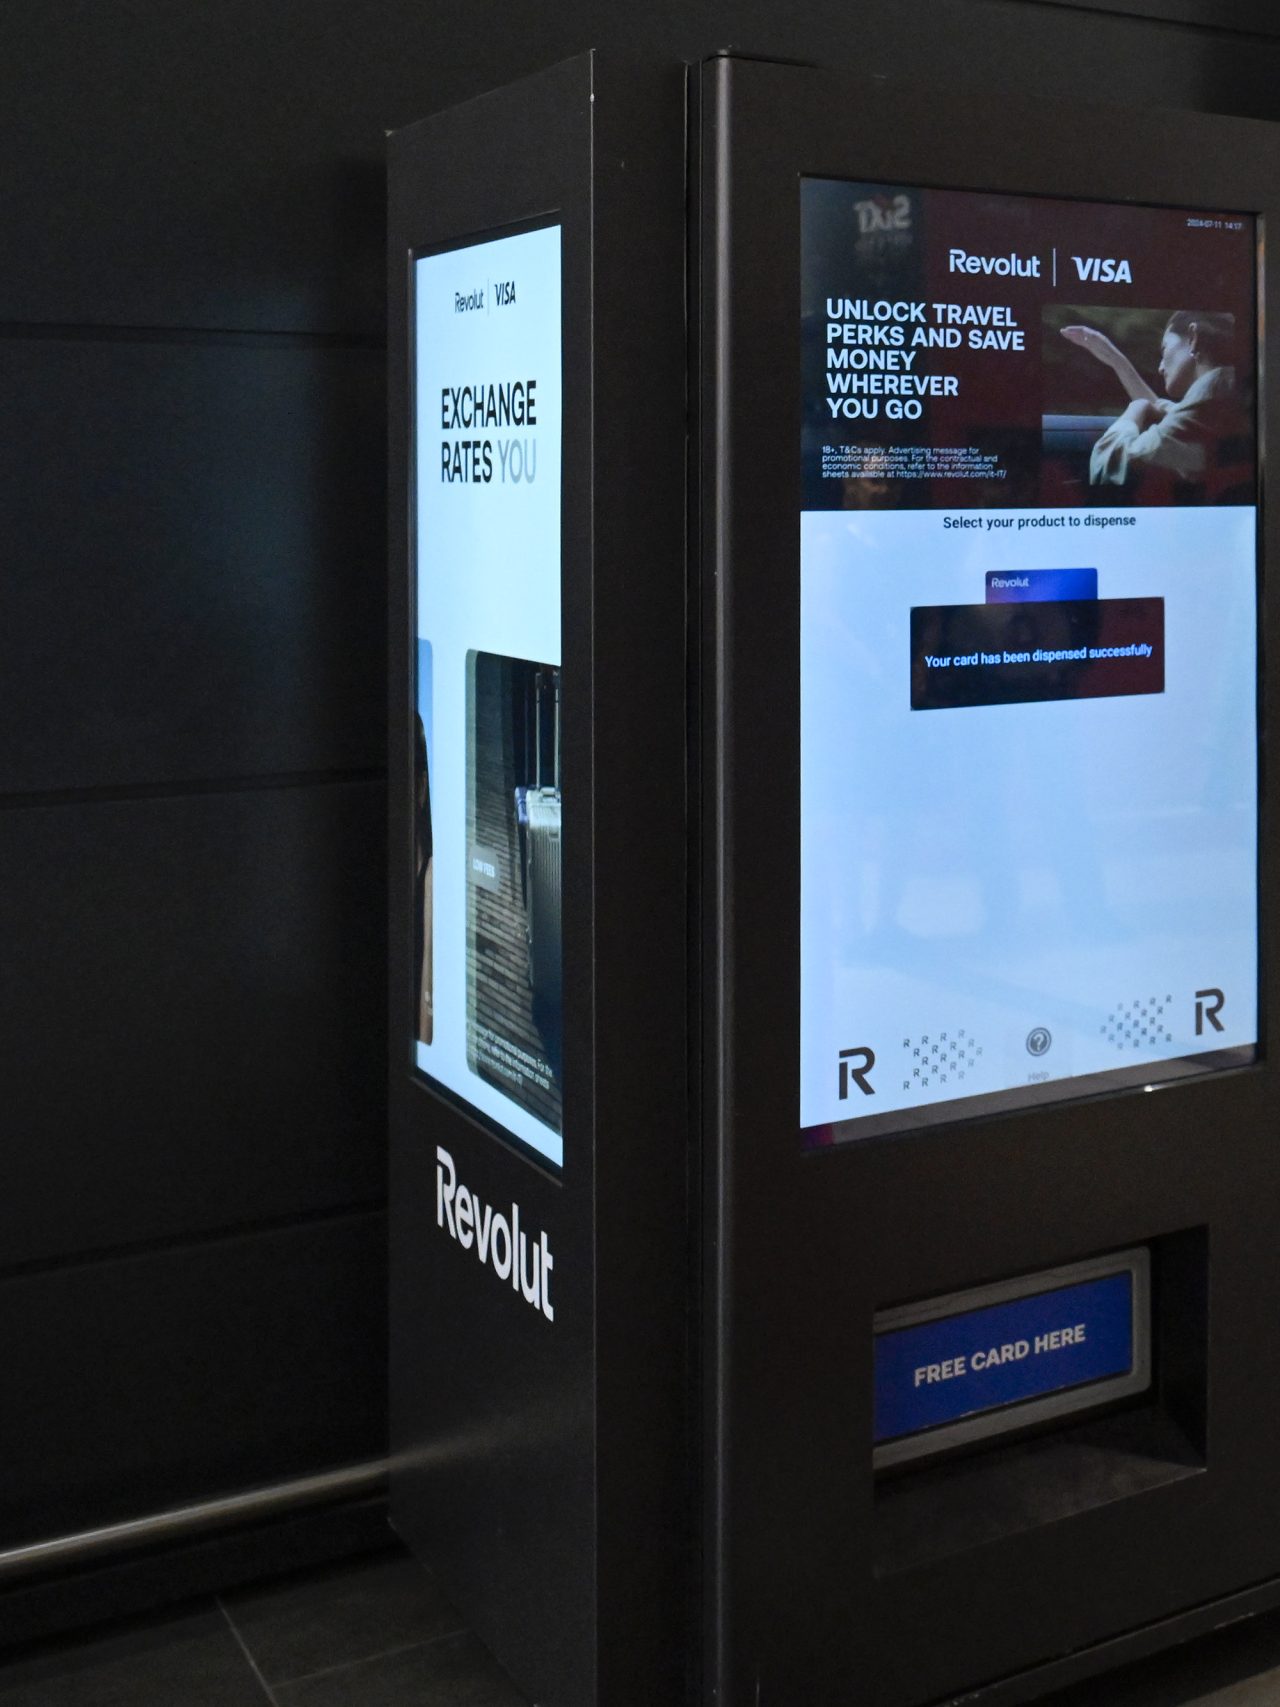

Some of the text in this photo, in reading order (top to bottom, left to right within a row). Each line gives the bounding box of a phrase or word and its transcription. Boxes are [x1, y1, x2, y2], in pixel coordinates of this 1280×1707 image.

[949, 248, 1133, 284] Revolut VISA
[454, 280, 516, 314] Revolut VISA
[826, 298, 1017, 327] UNLOCK TRAVEL
[826, 323, 1025, 351] PERKS AND SAVE
[826, 348, 917, 371] MONEY
[825, 372, 959, 396] WHEREVER
[441, 379, 537, 429] EXCHANGE
[825, 397, 923, 420] YOU GO
[441, 438, 537, 484] RATES YOU
[822, 454, 998, 463] promotional purposes. For the contractual and
[839, 445, 862, 454] T&Cs
[863, 446, 886, 456] apply.
[888, 446, 932, 456] Advertising
[932, 447, 968, 456] message
[968, 446, 980, 455] for
[822, 463, 994, 472] economic conditions, refer to the information
[822, 470, 850, 478] sheets
[943, 514, 1137, 531] Select your product to dispense
[991, 577, 1030, 588] Revolut
[925, 643, 1153, 668] Your card has been dispensed successfully
[436, 1145, 555, 1322] Revolut
[914, 1323, 1087, 1388] FREE CARD HERE
